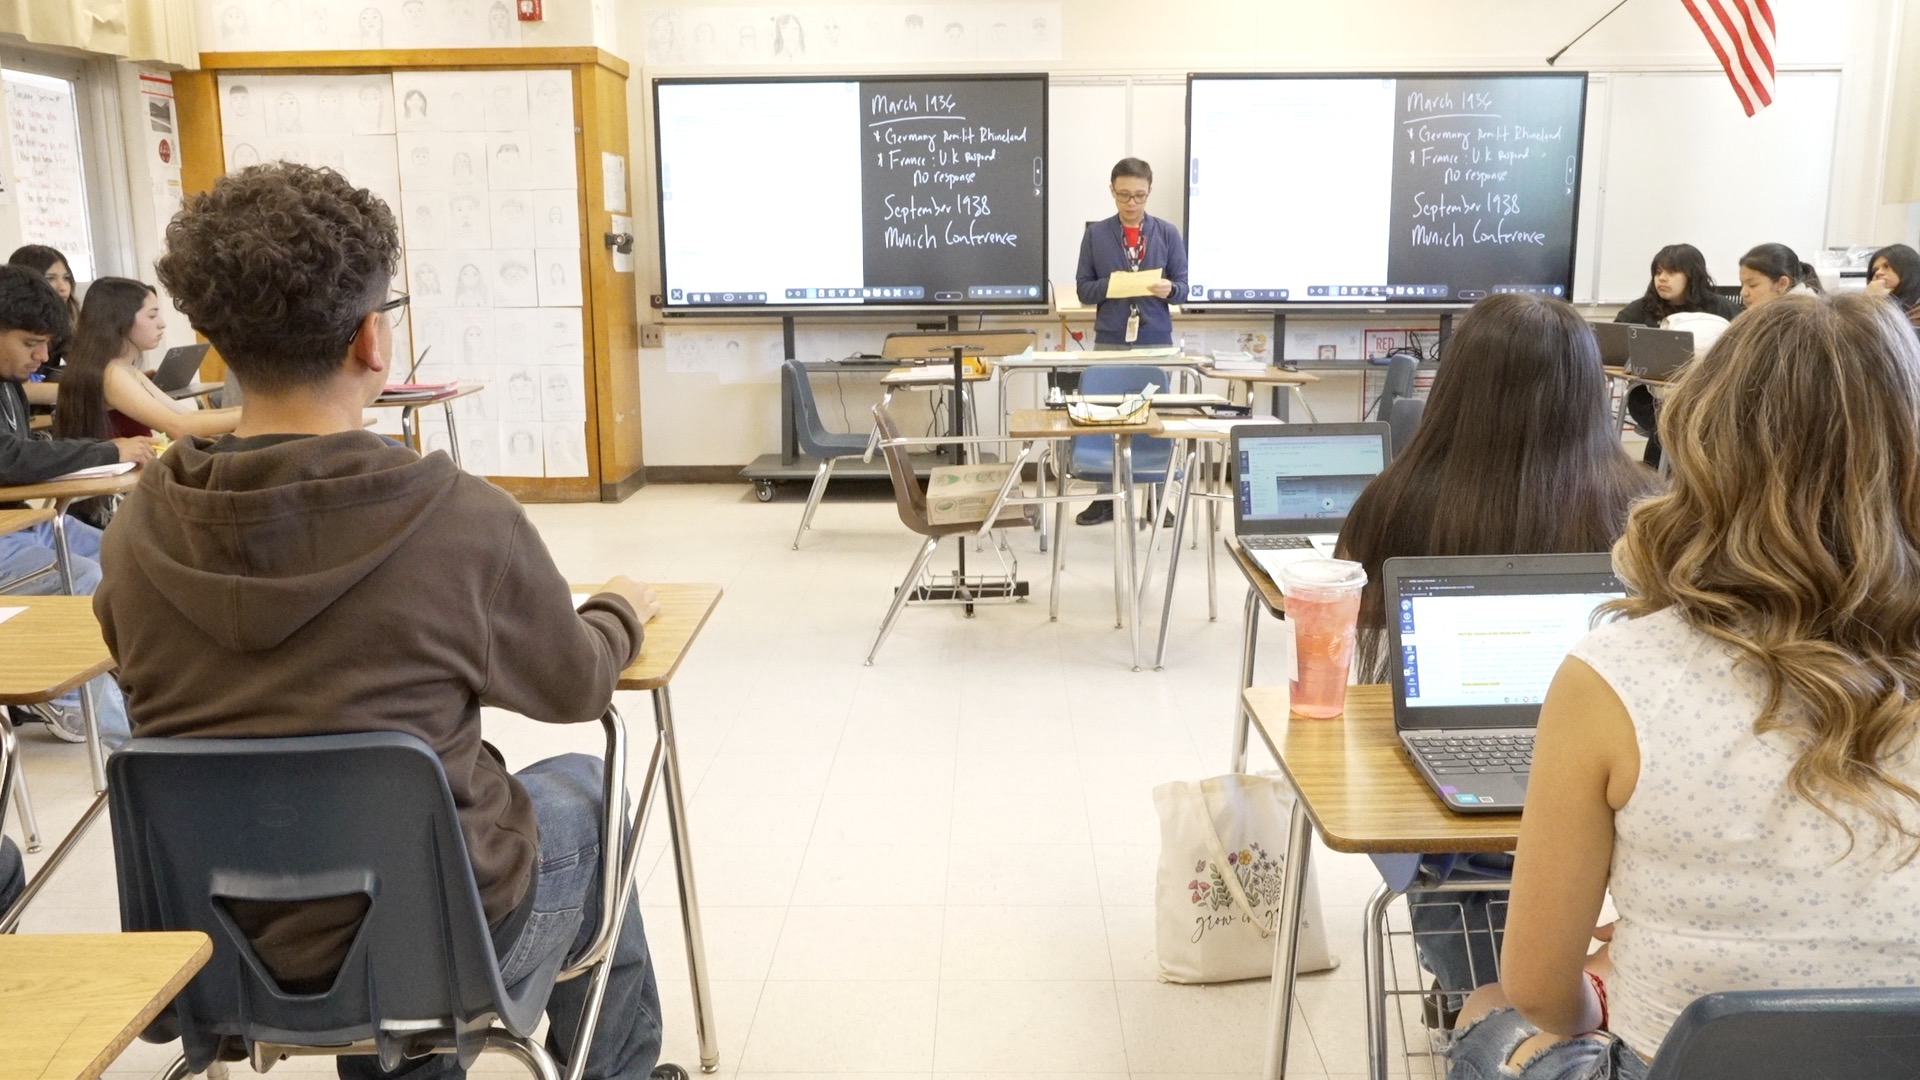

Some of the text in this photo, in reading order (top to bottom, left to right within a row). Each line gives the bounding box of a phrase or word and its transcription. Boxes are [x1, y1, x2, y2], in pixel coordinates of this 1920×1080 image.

[872, 94, 957, 115] March 1936
[1407, 92, 1493, 112] March 1936
[885, 127, 937, 152] Germany
[979, 126, 1027, 144] Rhineland
[1419, 125, 1471, 149] Germany
[1514, 125, 1562, 141] Rhineland
[888, 150, 926, 169] France
[1421, 148, 1459, 167] France
[934, 171, 976, 190] response
[1465, 169, 1508, 188] response
[884, 193, 991, 223] September 1938
[1412, 191, 1520, 221] September 1938
[885, 220, 1018, 249] Munich Conference
[1412, 218, 1546, 247] Munich Conference
[1376, 337, 1395, 350] RED
[1631, 328, 1638, 339] 3
[1191, 914, 1236, 943] grow
